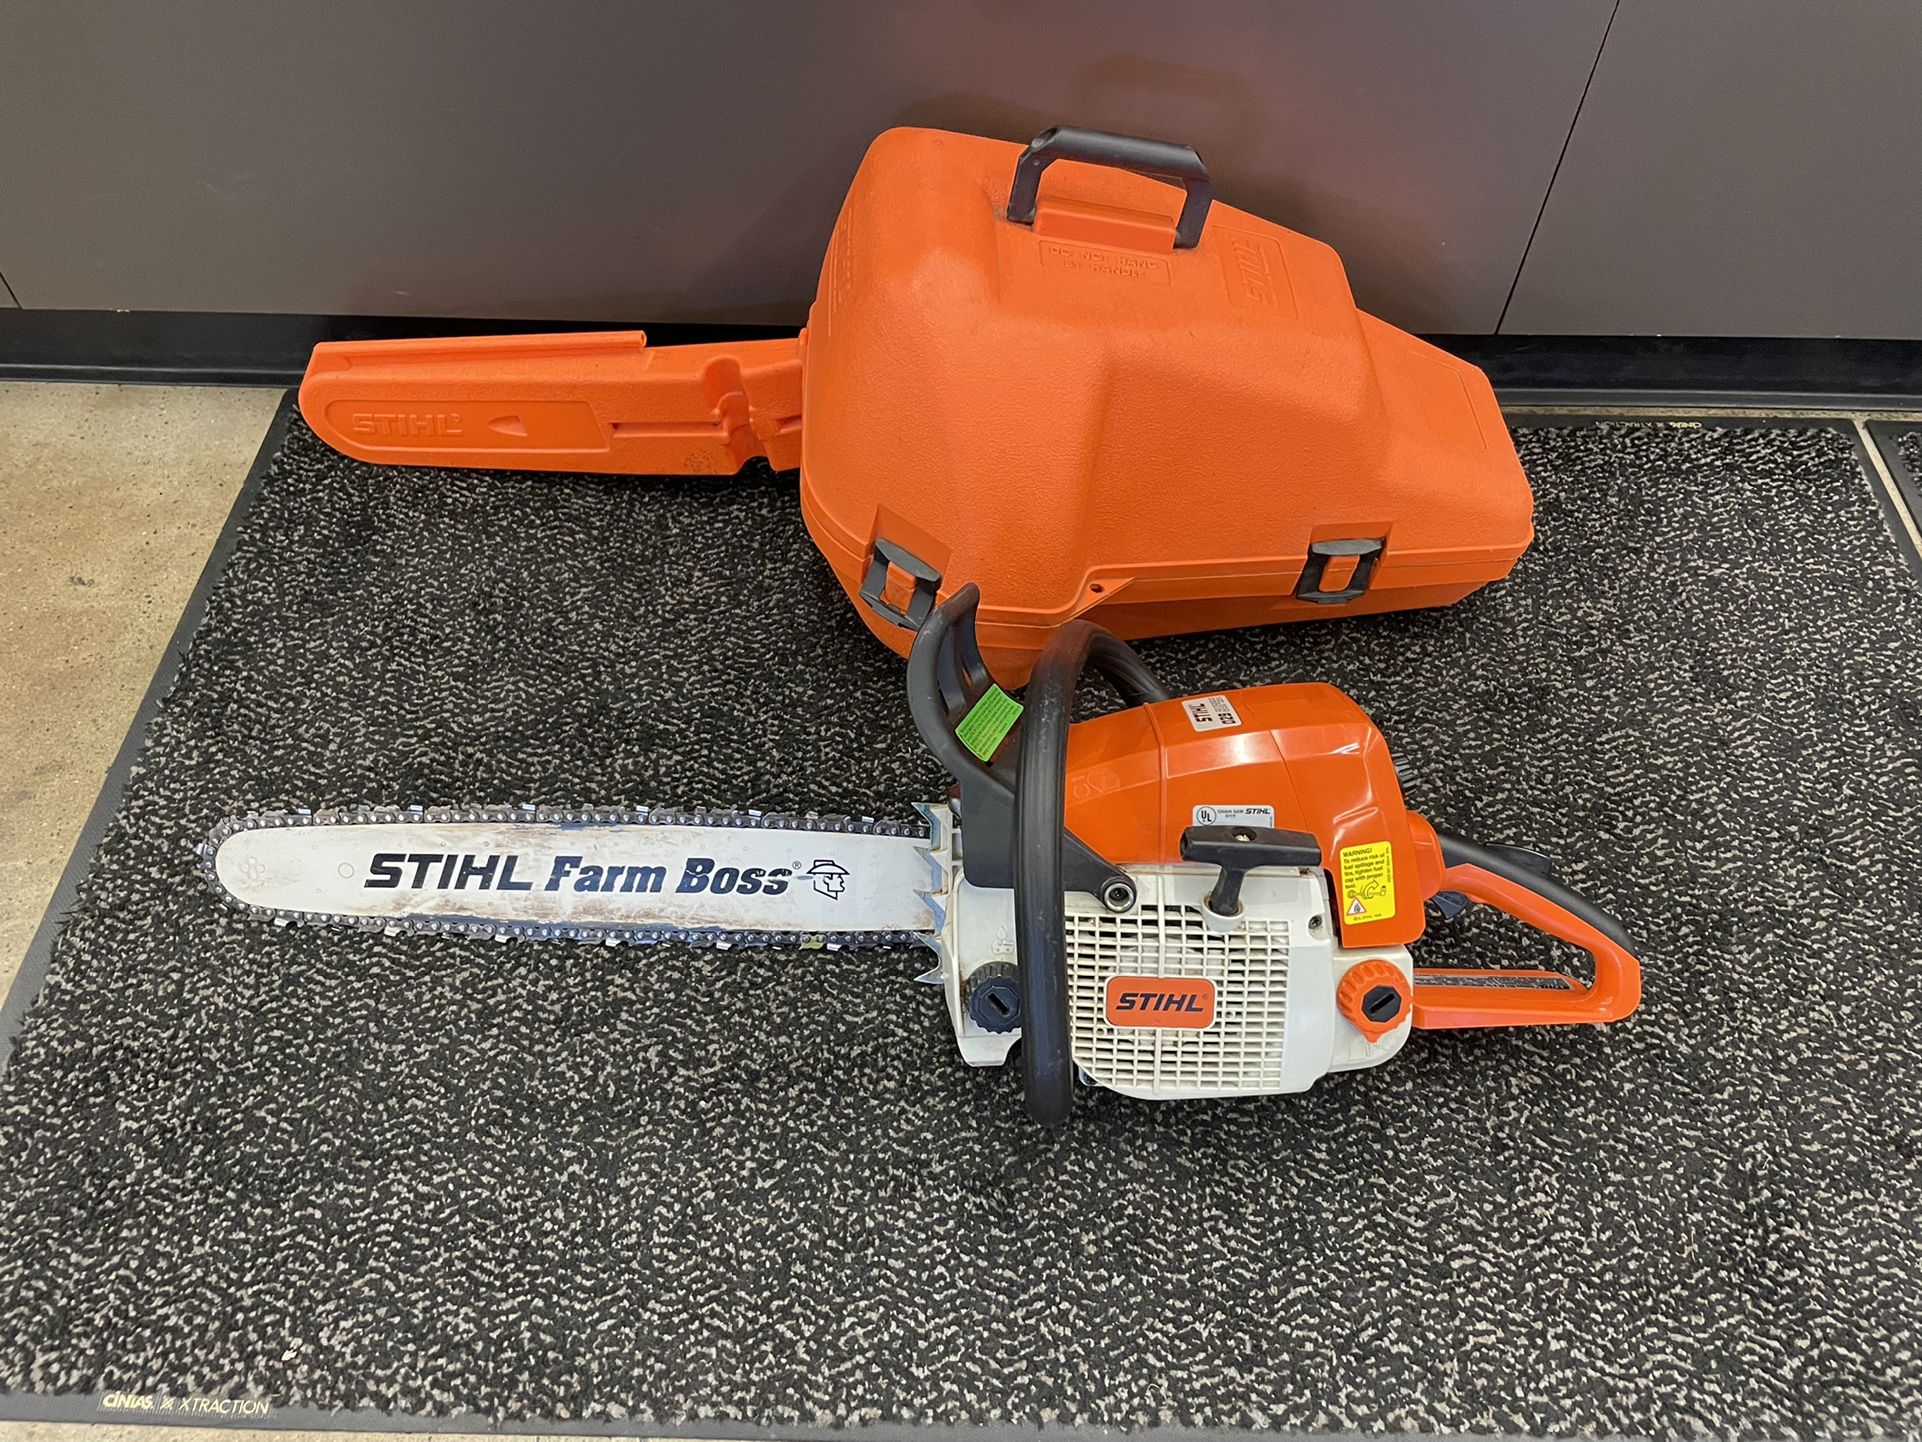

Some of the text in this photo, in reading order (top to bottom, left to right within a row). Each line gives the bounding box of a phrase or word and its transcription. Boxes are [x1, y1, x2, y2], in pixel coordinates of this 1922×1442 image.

[353, 413, 463, 437] STIHL
[1343, 848, 1372, 857] WARNING!
[1354, 861, 1374, 870] spillage
[1355, 868, 1373, 876] tighten
[364, 853, 534, 891] STIHL
[544, 855, 668, 893] Farm
[1366, 872, 1384, 881] proper
[1115, 992, 1204, 1013] STIHL
[179, 1396, 271, 1415] XTRACTION
